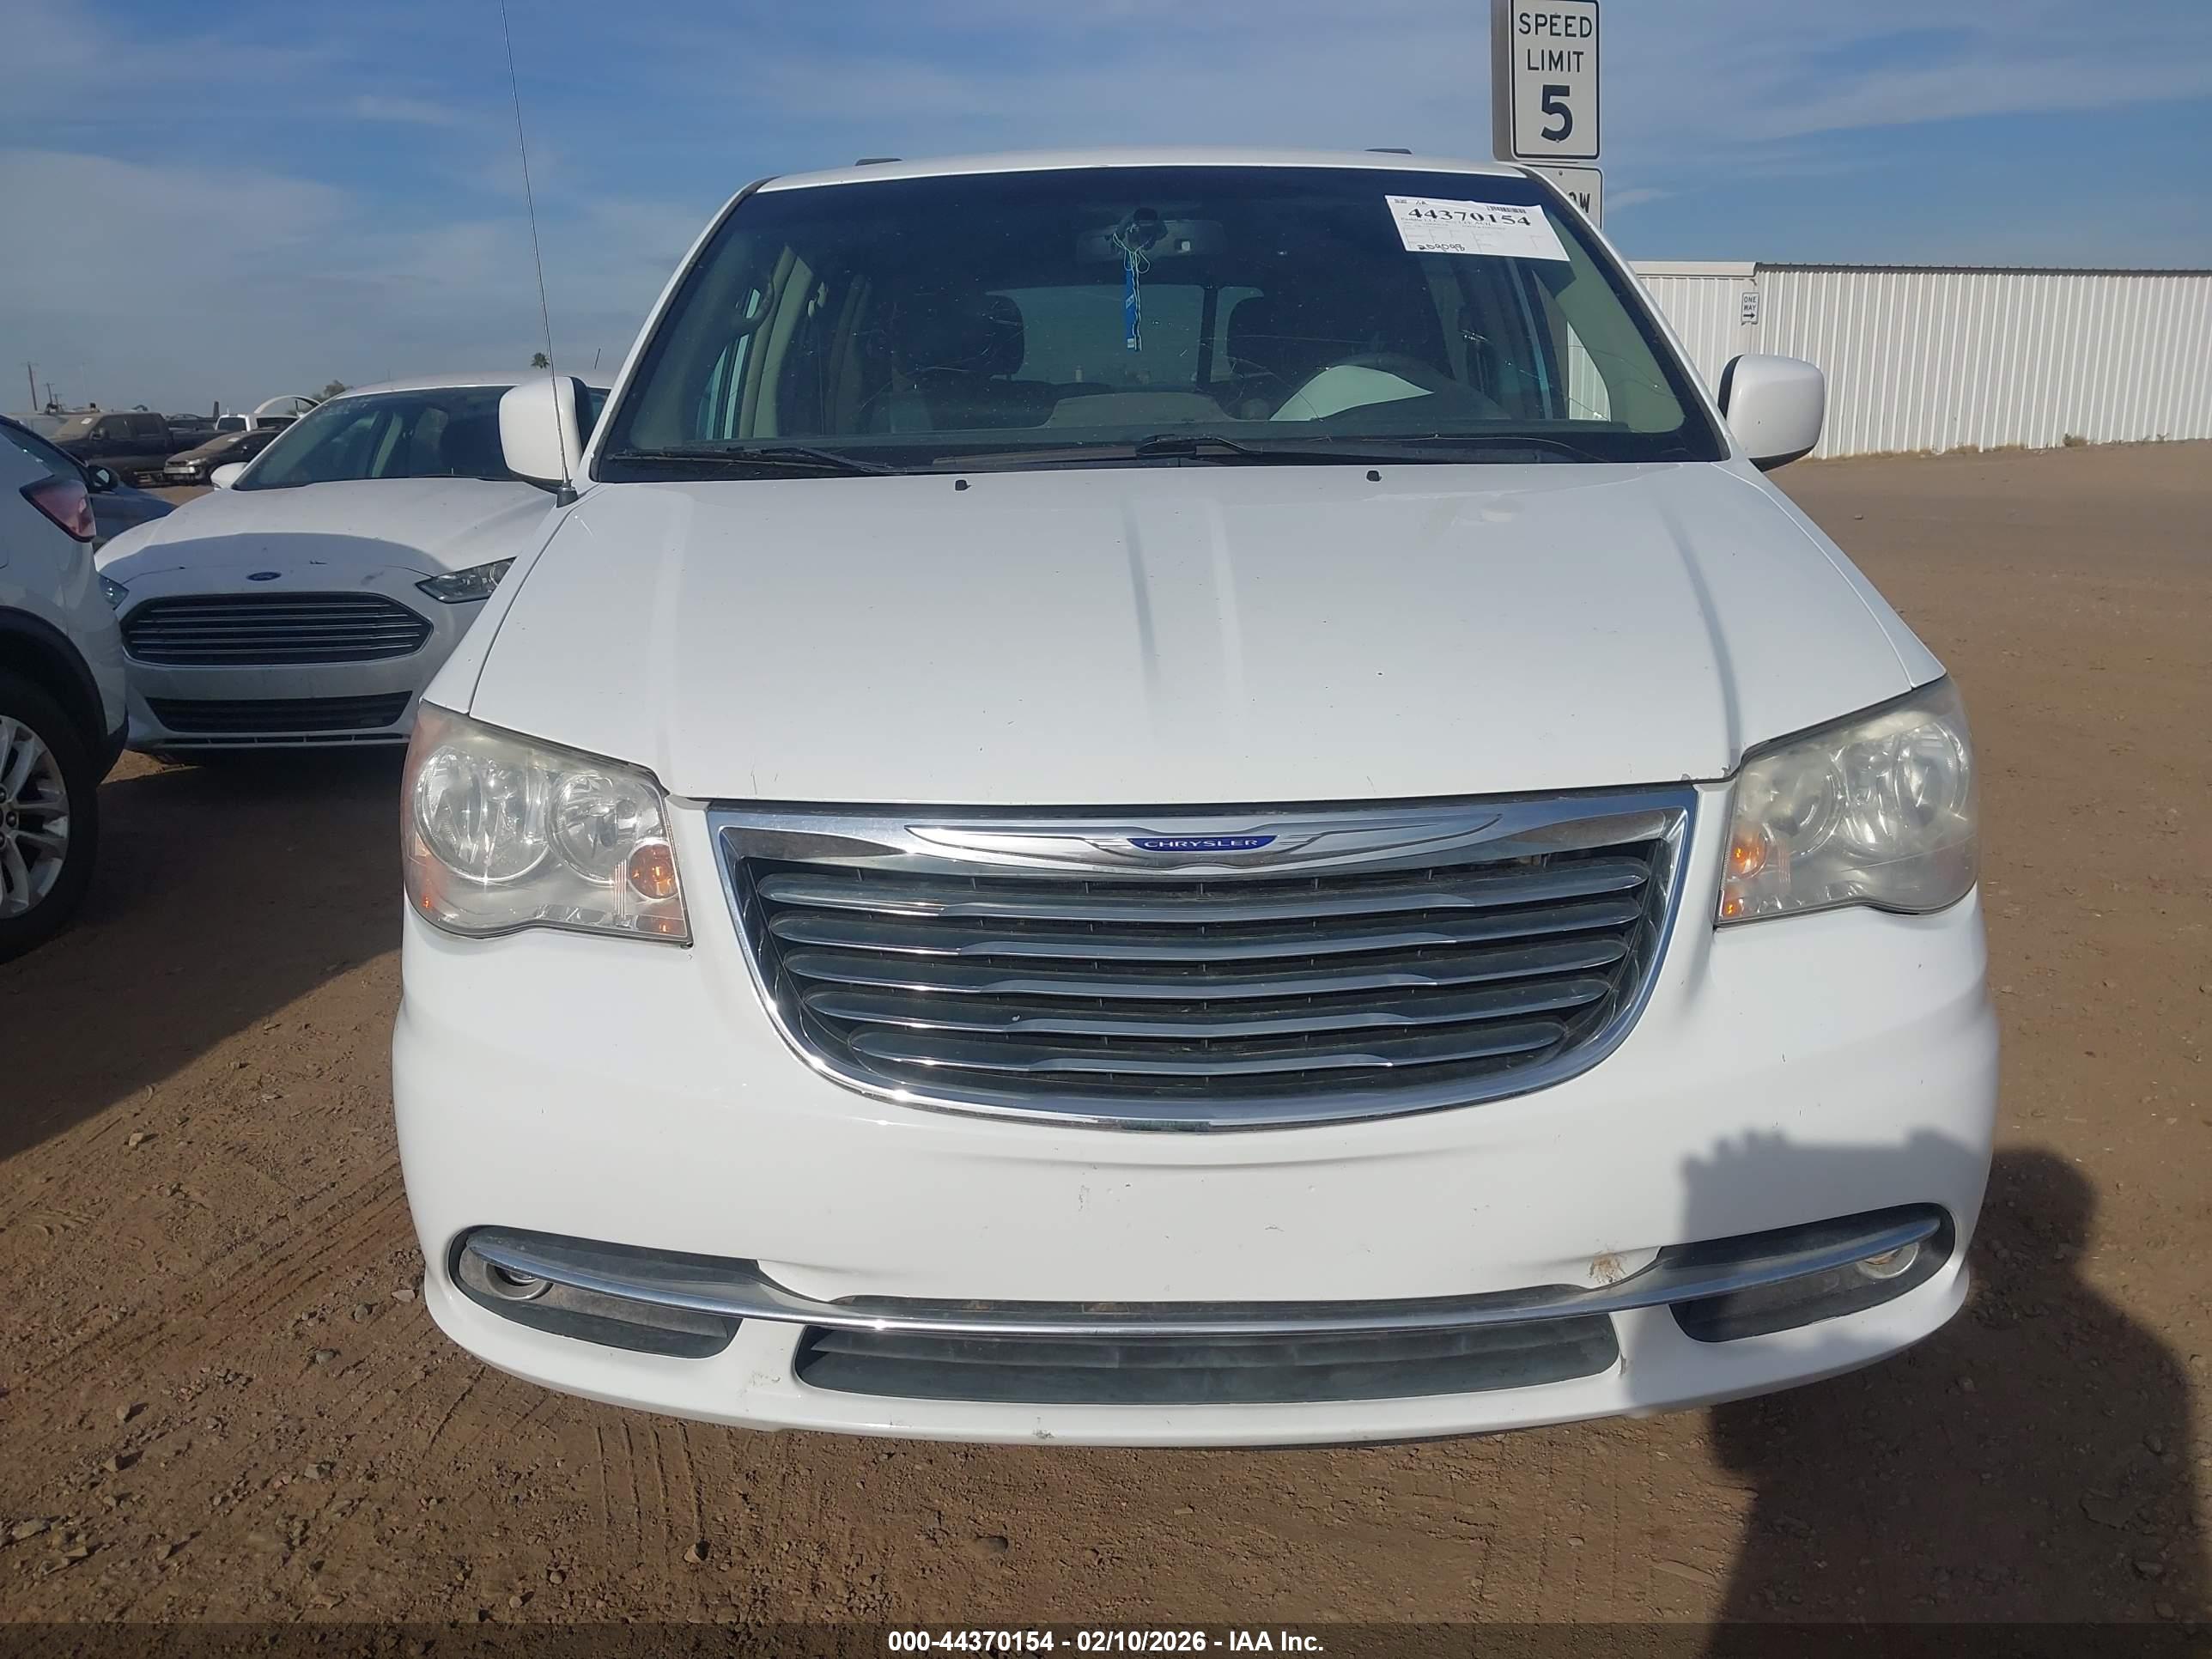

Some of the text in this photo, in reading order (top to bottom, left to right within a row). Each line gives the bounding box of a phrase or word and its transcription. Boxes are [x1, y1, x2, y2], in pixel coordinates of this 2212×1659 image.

[1518, 12, 1593, 38] SPEED
[1527, 49, 1584, 73] LIMIT
[1540, 84, 1573, 143] 5
[1408, 208, 1531, 227] 44370154
[1144, 839, 1258, 848] CHRYSLER
